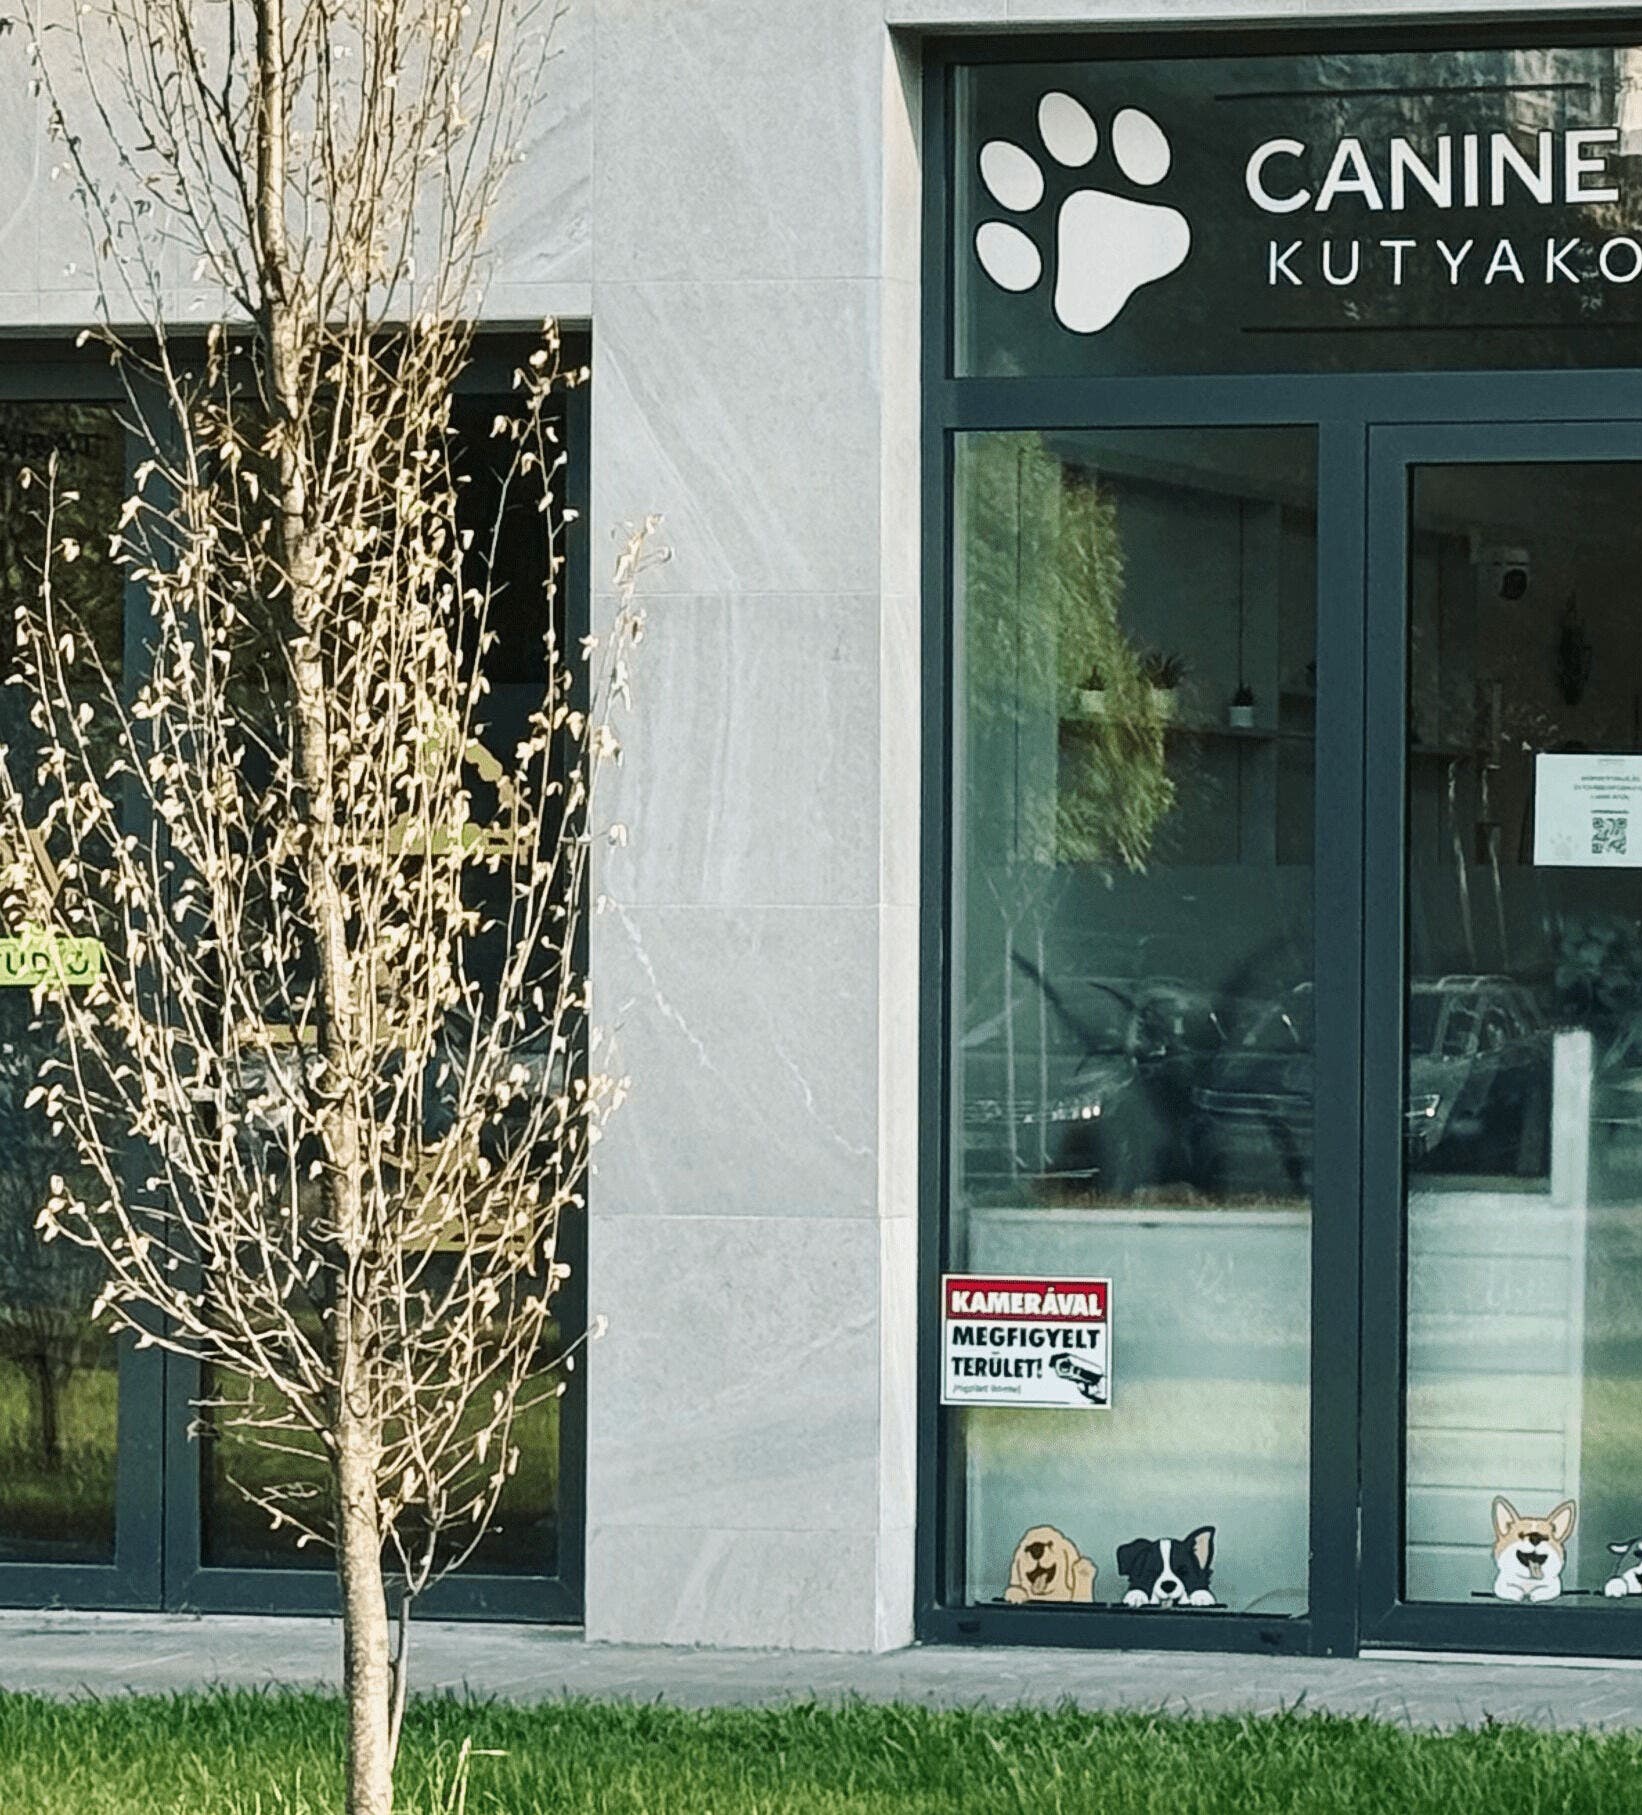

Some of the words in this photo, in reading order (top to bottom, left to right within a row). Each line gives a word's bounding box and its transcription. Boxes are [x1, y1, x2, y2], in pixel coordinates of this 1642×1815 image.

[1245, 128, 1620, 213] CANINE
[951, 1286, 1102, 1316] KAMERÁVAL
[952, 1325, 1101, 1349] MEGFIGYELT
[951, 1351, 1043, 1379] TERÜLET!
